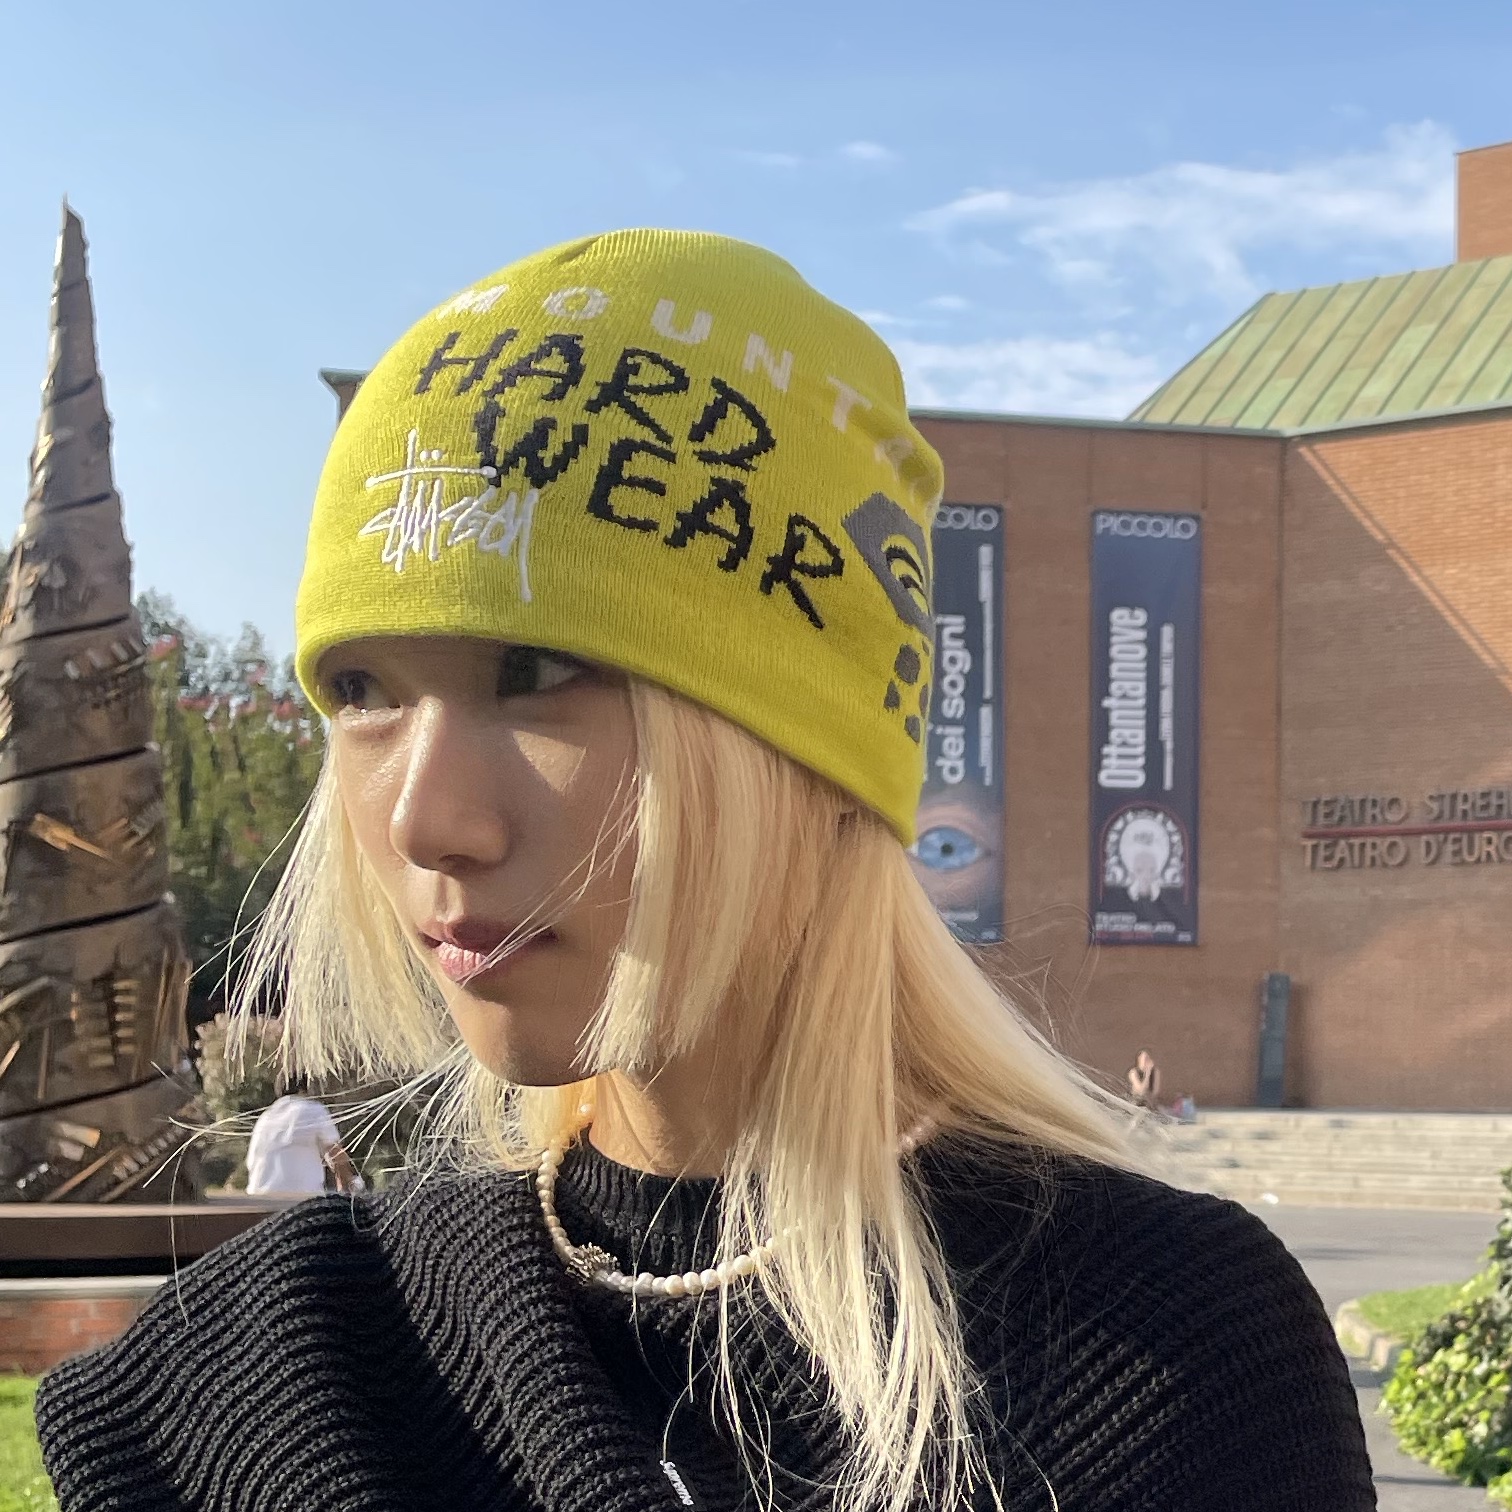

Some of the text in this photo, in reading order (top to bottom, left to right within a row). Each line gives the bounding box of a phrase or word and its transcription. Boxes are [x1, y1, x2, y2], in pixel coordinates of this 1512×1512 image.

[414, 328, 777, 472] HARD
[472, 399, 845, 629] WEAR
[1096, 513, 1197, 540] PICCOLO
[935, 613, 972, 785] dei sogni
[1098, 606, 1148, 790] Ottantanove
[1301, 836, 1408, 871] TEATRO
[1302, 795, 1408, 826] TEATRO
